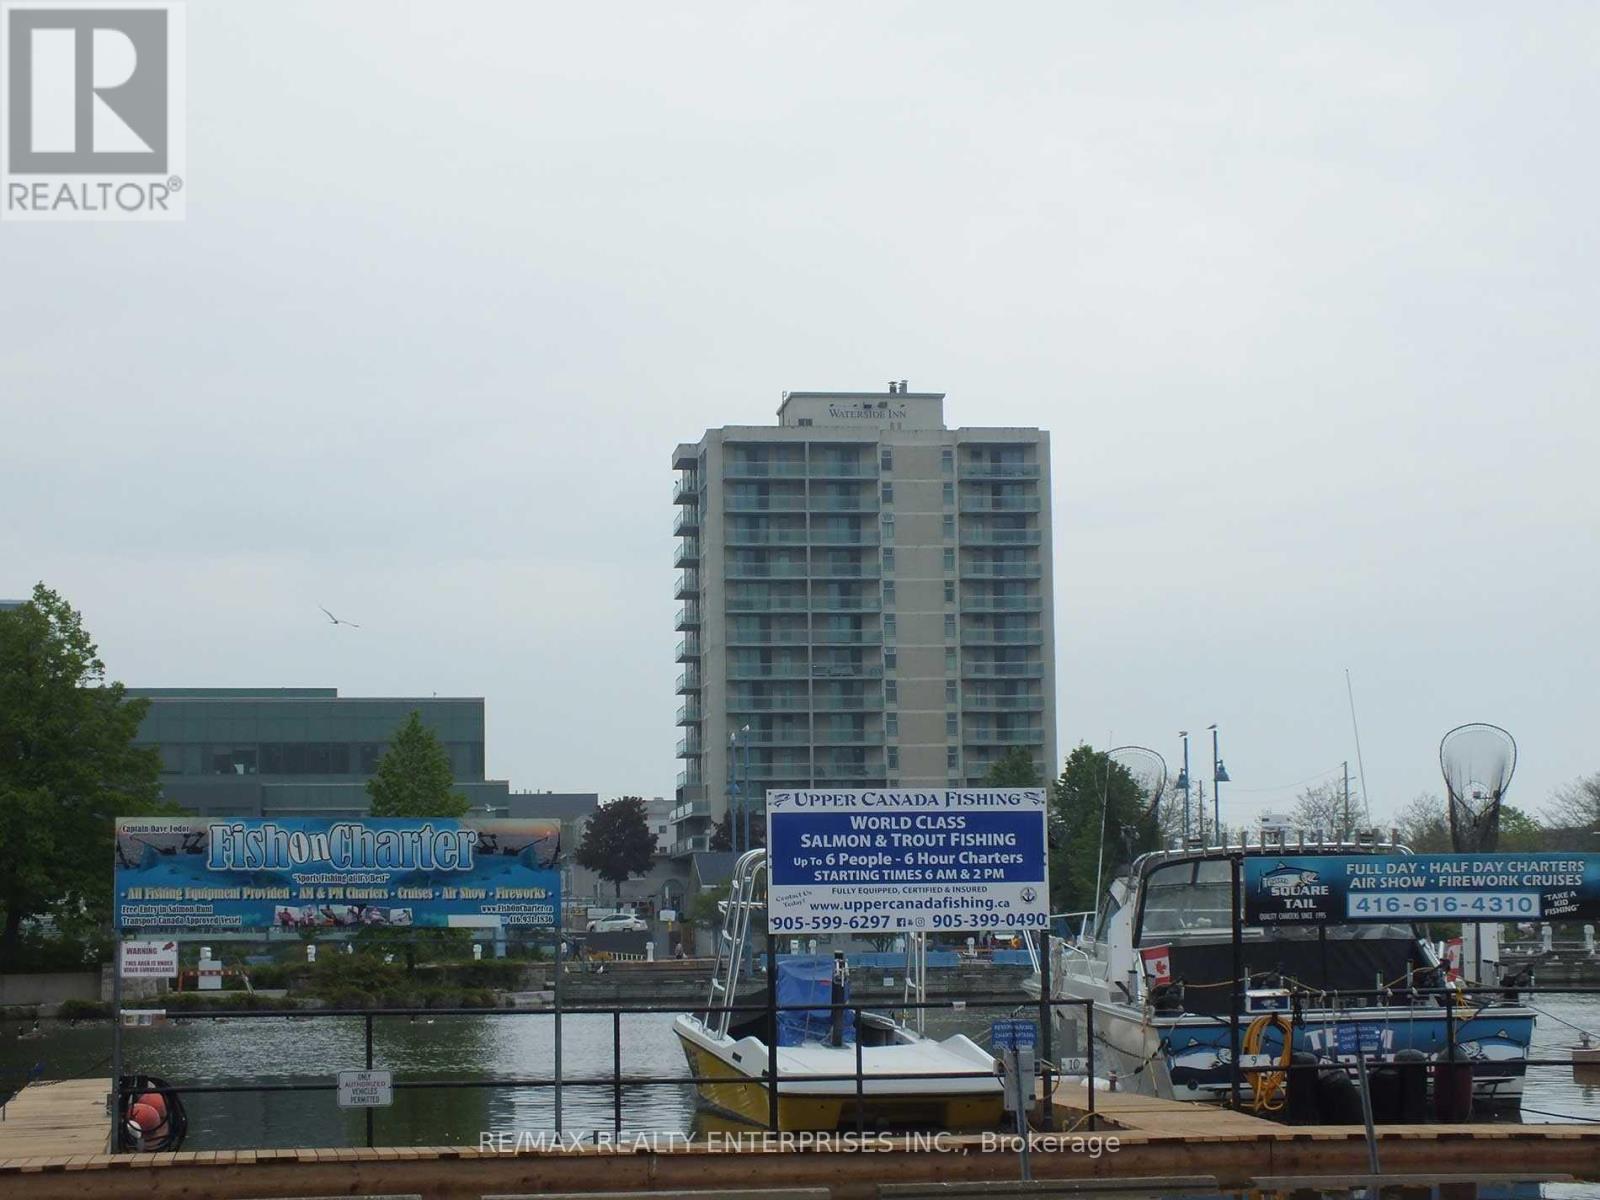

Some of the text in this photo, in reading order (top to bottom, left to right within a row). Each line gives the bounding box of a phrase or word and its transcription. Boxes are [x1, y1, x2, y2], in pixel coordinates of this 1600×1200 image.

[888, 409, 906, 418] INN
[794, 791, 1021, 807] UPPER CANADA FISHING
[122, 824, 149, 834] Captain
[150, 824, 167, 833] Dave
[850, 815, 966, 830] WORLD CLASS
[801, 832, 1016, 848] SALMON & TROUT FISHING
[810, 857, 822, 866] To
[825, 853, 835, 866] 6
[839, 853, 892, 869] People
[904, 853, 914, 865] 6
[918, 852, 956, 865] Hour
[959, 852, 1023, 864] Charters
[814, 868, 1005, 881] STARTING TIMES 6 AM & 2 PM
[1346, 861, 1585, 875] FULL DAY HALF DAY CHARTERS
[1350, 874, 1583, 889] AIR SHOW FIREWORK CRUISES
[128, 887, 546, 901] All Fishing Equipment Provided AM & PM Charters Cruises Air Show Fireworks
[831, 885, 988, 896] FULLY EQUIPPED, CERTIFIED & INSURED
[1271, 885, 1329, 896] SQUARE
[122, 905, 138, 914] Free
[139, 905, 157, 915] Entry
[158, 905, 167, 914] in
[168, 905, 194, 914] Salmon
[809, 896, 1011, 911] www.uppercanadafishing.ca
[1283, 899, 1318, 909] TAIL
[1356, 896, 1533, 913] 416-616-4310
[122, 916, 158, 926] Transport
[158, 916, 183, 925] Canada
[185, 916, 219, 926] Approved
[773, 914, 890, 930] 905-599-6297
[932, 912, 1046, 927] 905-399-0490
[126, 947, 158, 955] WARNING
[1069, 1058, 1081, 1072] 10
[1250, 1055, 1258, 1066] 9
[351, 1088, 378, 1096] VEHICLES
[350, 1096, 380, 1104] PERMITTED
